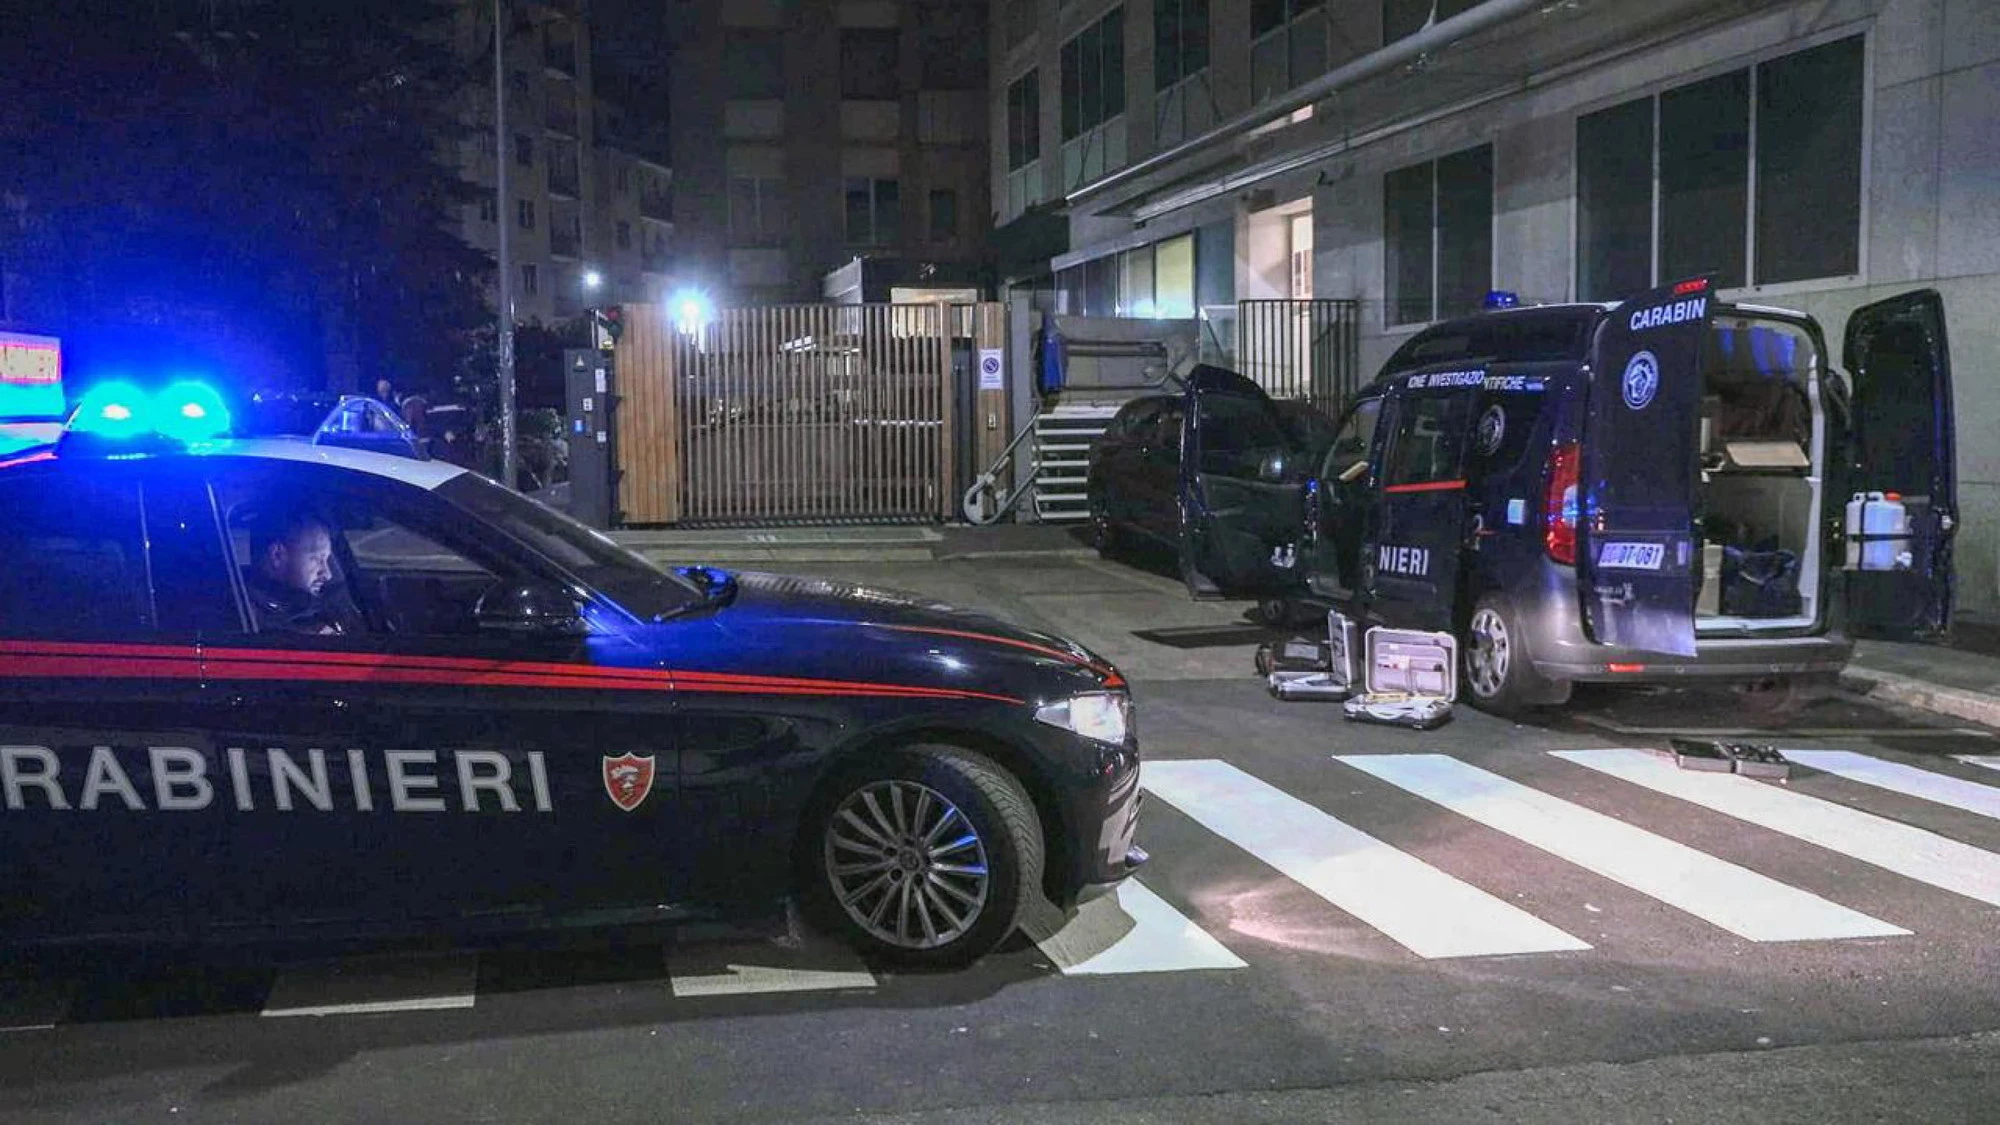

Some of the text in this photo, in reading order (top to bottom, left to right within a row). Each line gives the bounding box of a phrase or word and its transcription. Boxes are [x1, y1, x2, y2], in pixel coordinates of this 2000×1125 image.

[1630, 298, 1706, 331] CARABIN
[1379, 544, 1429, 576] NIERI
[0, 744, 554, 812] RABINIERI
